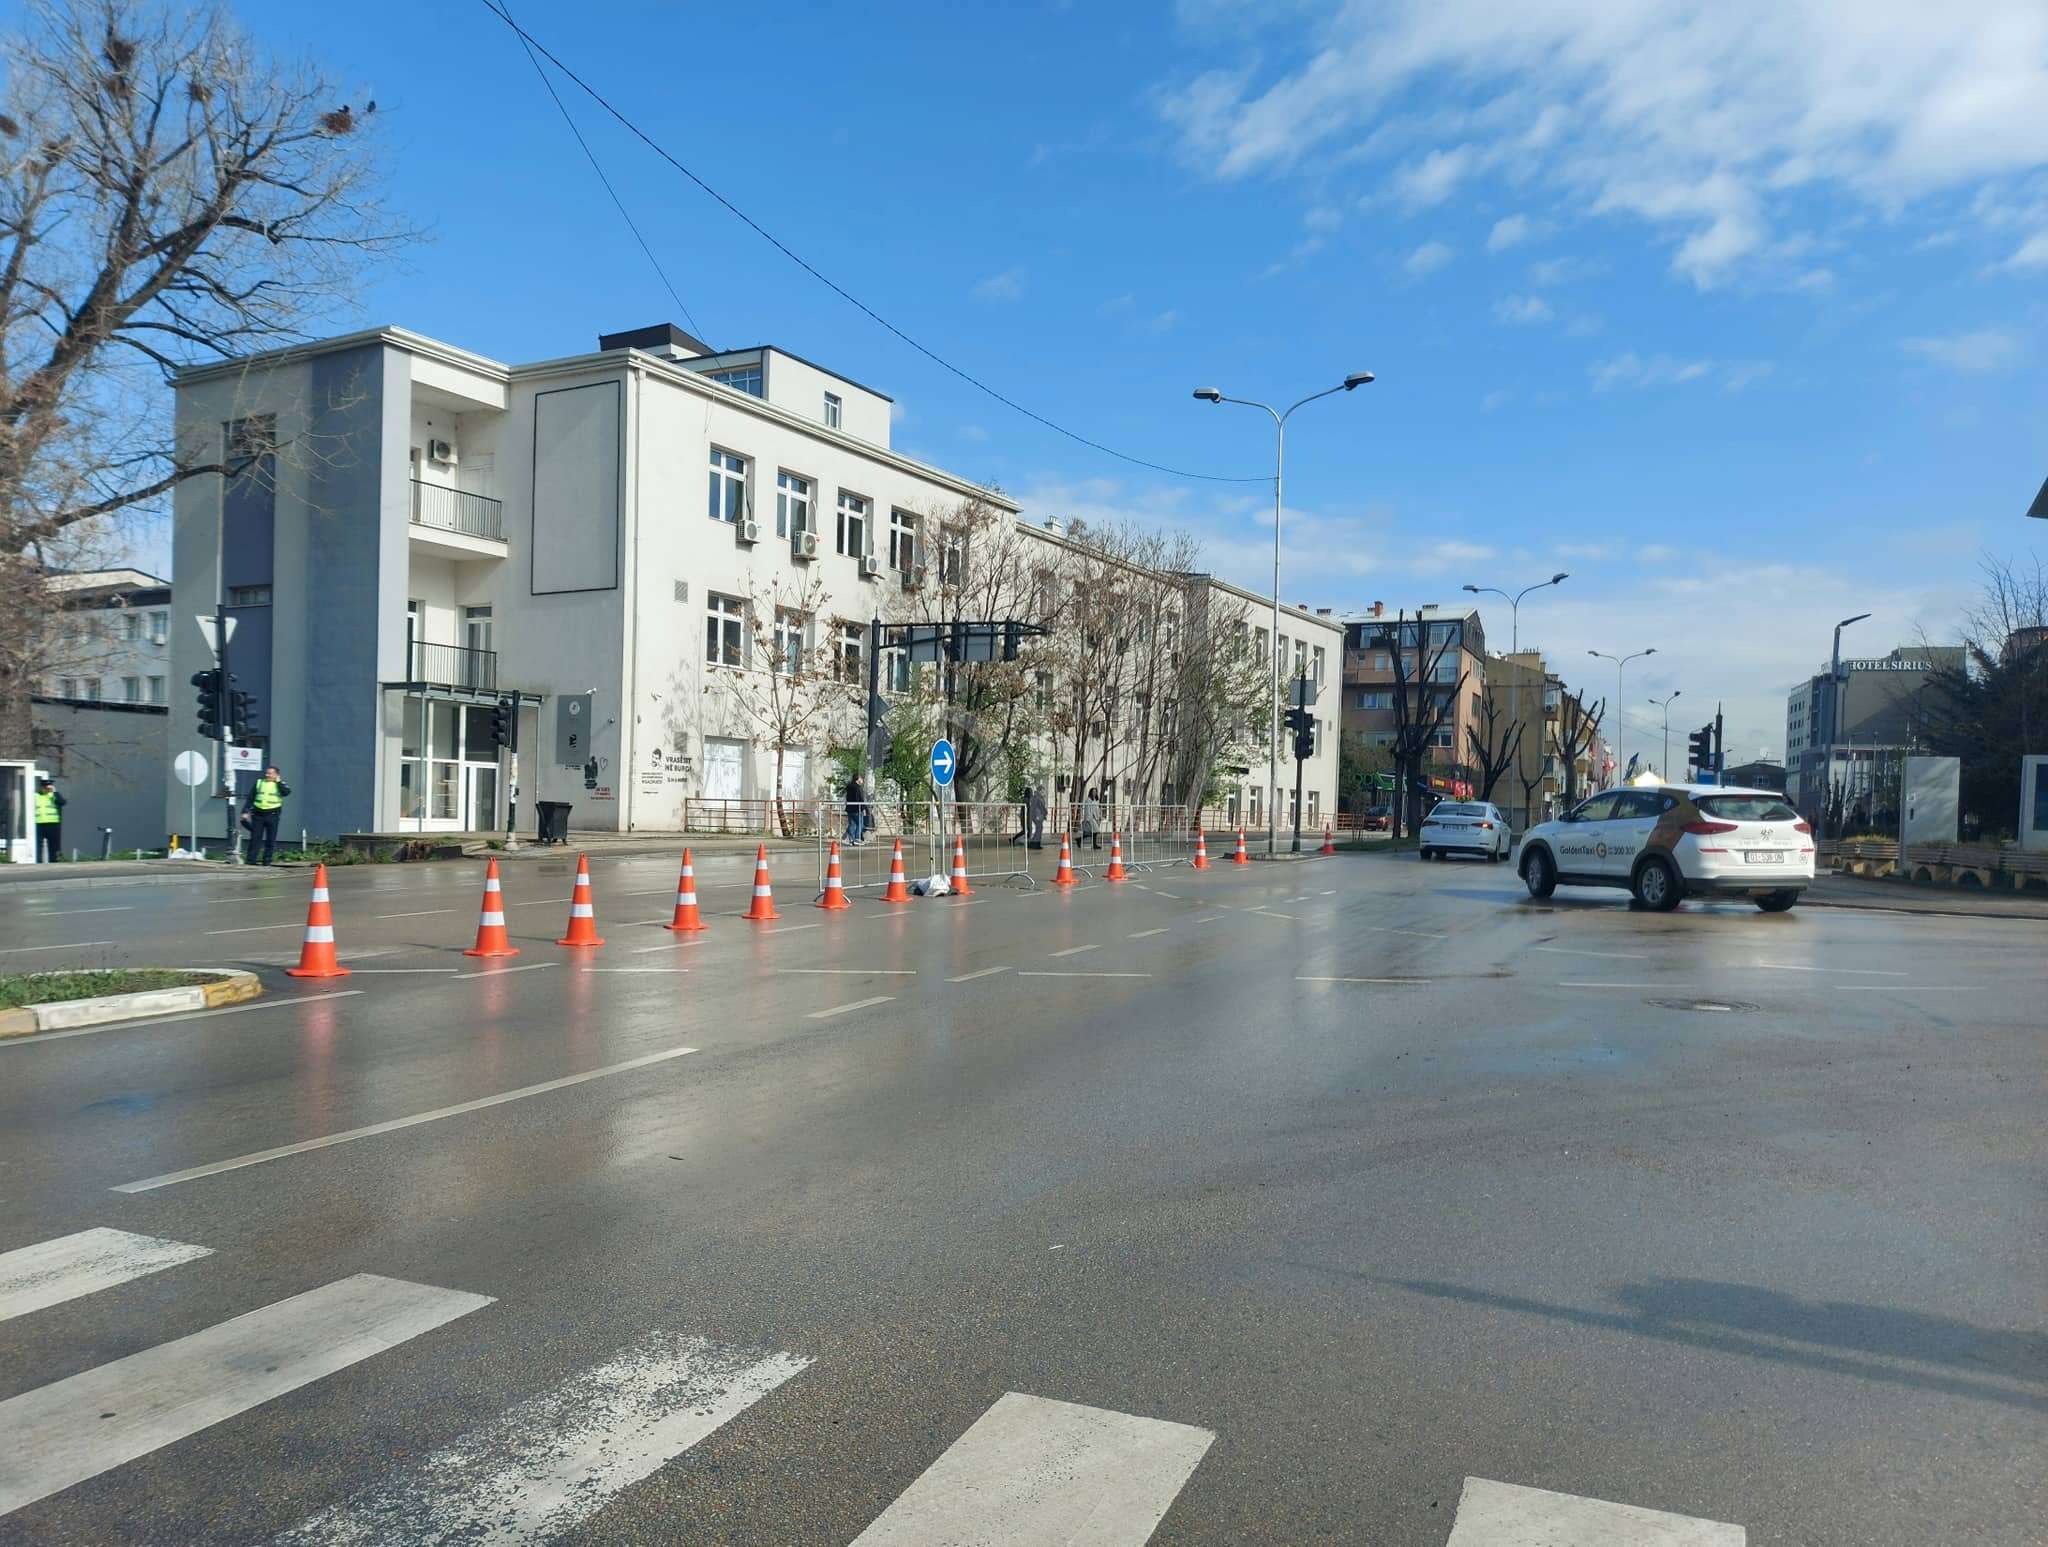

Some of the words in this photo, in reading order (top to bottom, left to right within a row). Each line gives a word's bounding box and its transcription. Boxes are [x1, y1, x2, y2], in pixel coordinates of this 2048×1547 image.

[1848, 661, 1889, 671] HOTEL
[1891, 661, 1932, 671] SIRIUS
[1560, 845, 1596, 855] GoldenTaxi
